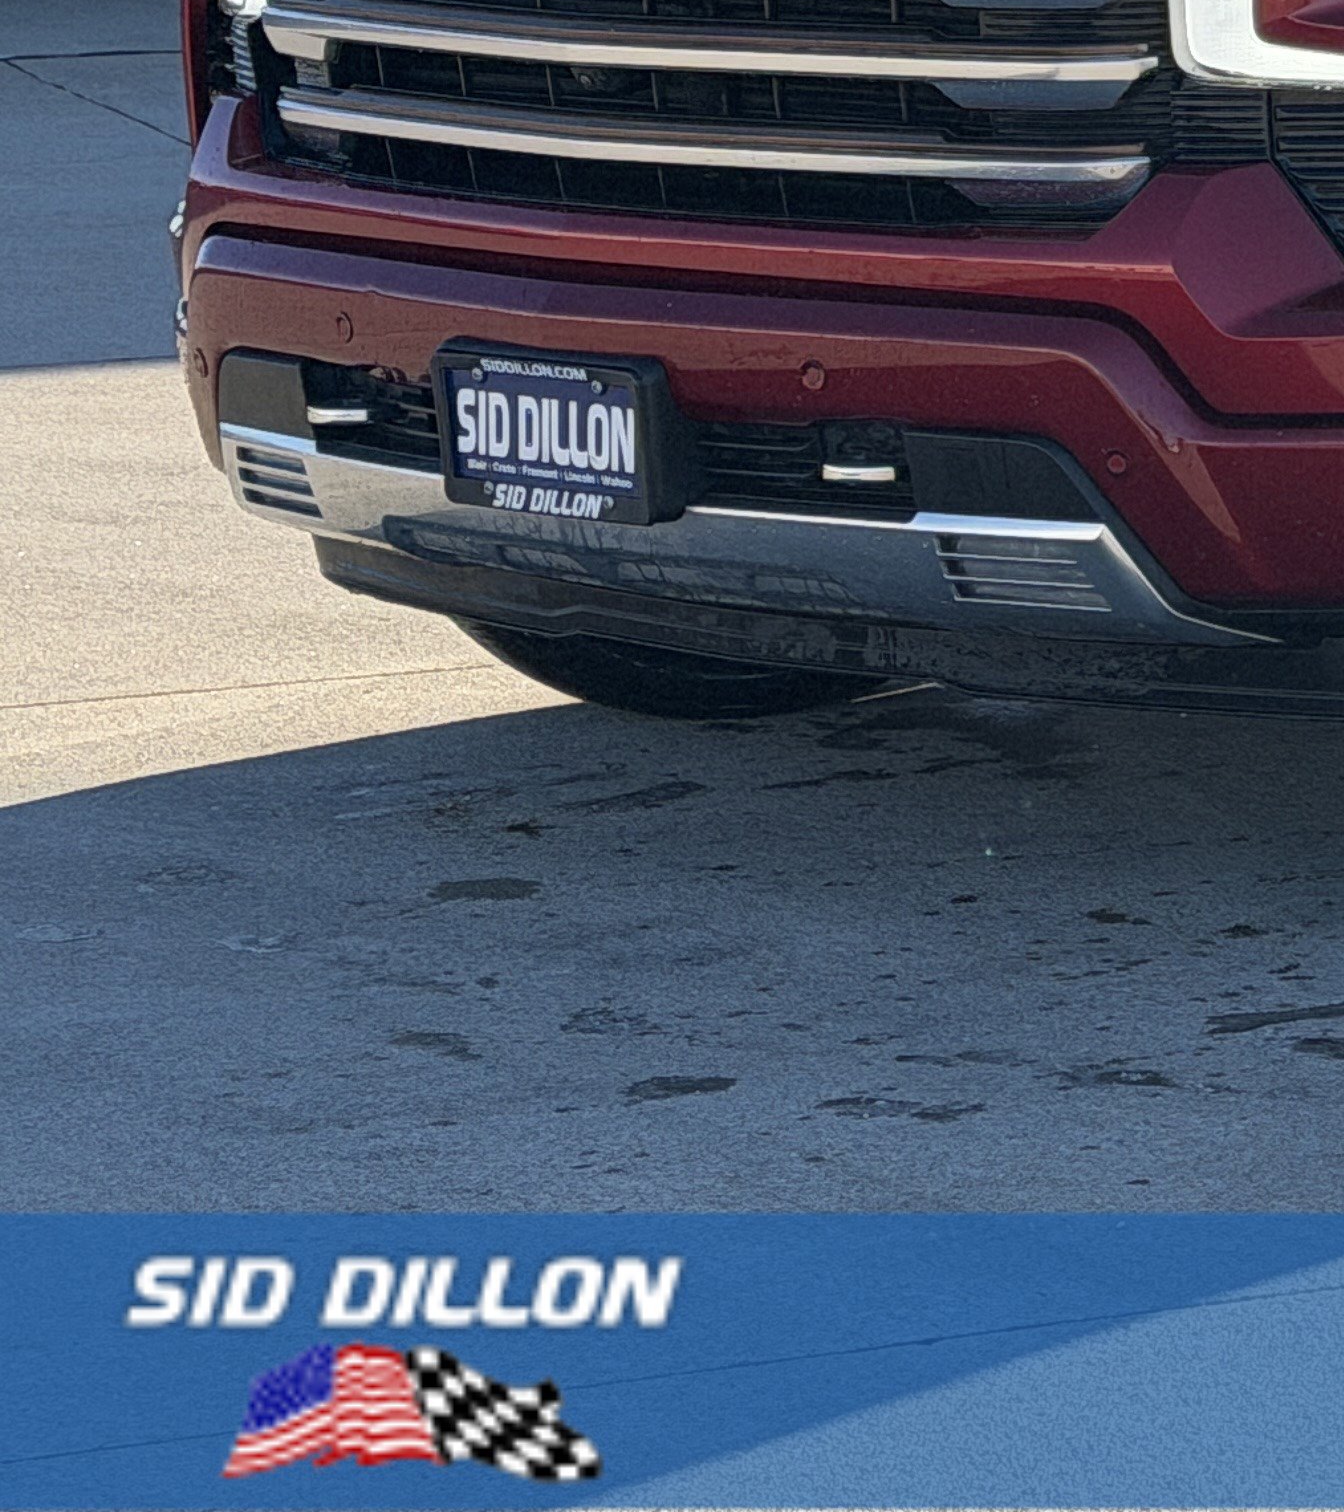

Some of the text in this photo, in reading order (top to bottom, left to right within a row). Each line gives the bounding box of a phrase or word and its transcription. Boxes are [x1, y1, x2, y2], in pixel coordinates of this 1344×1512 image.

[480, 358, 588, 381] SIDDILLON.COM
[457, 388, 635, 473] SID DILLON
[492, 483, 602, 519] SID DILLON
